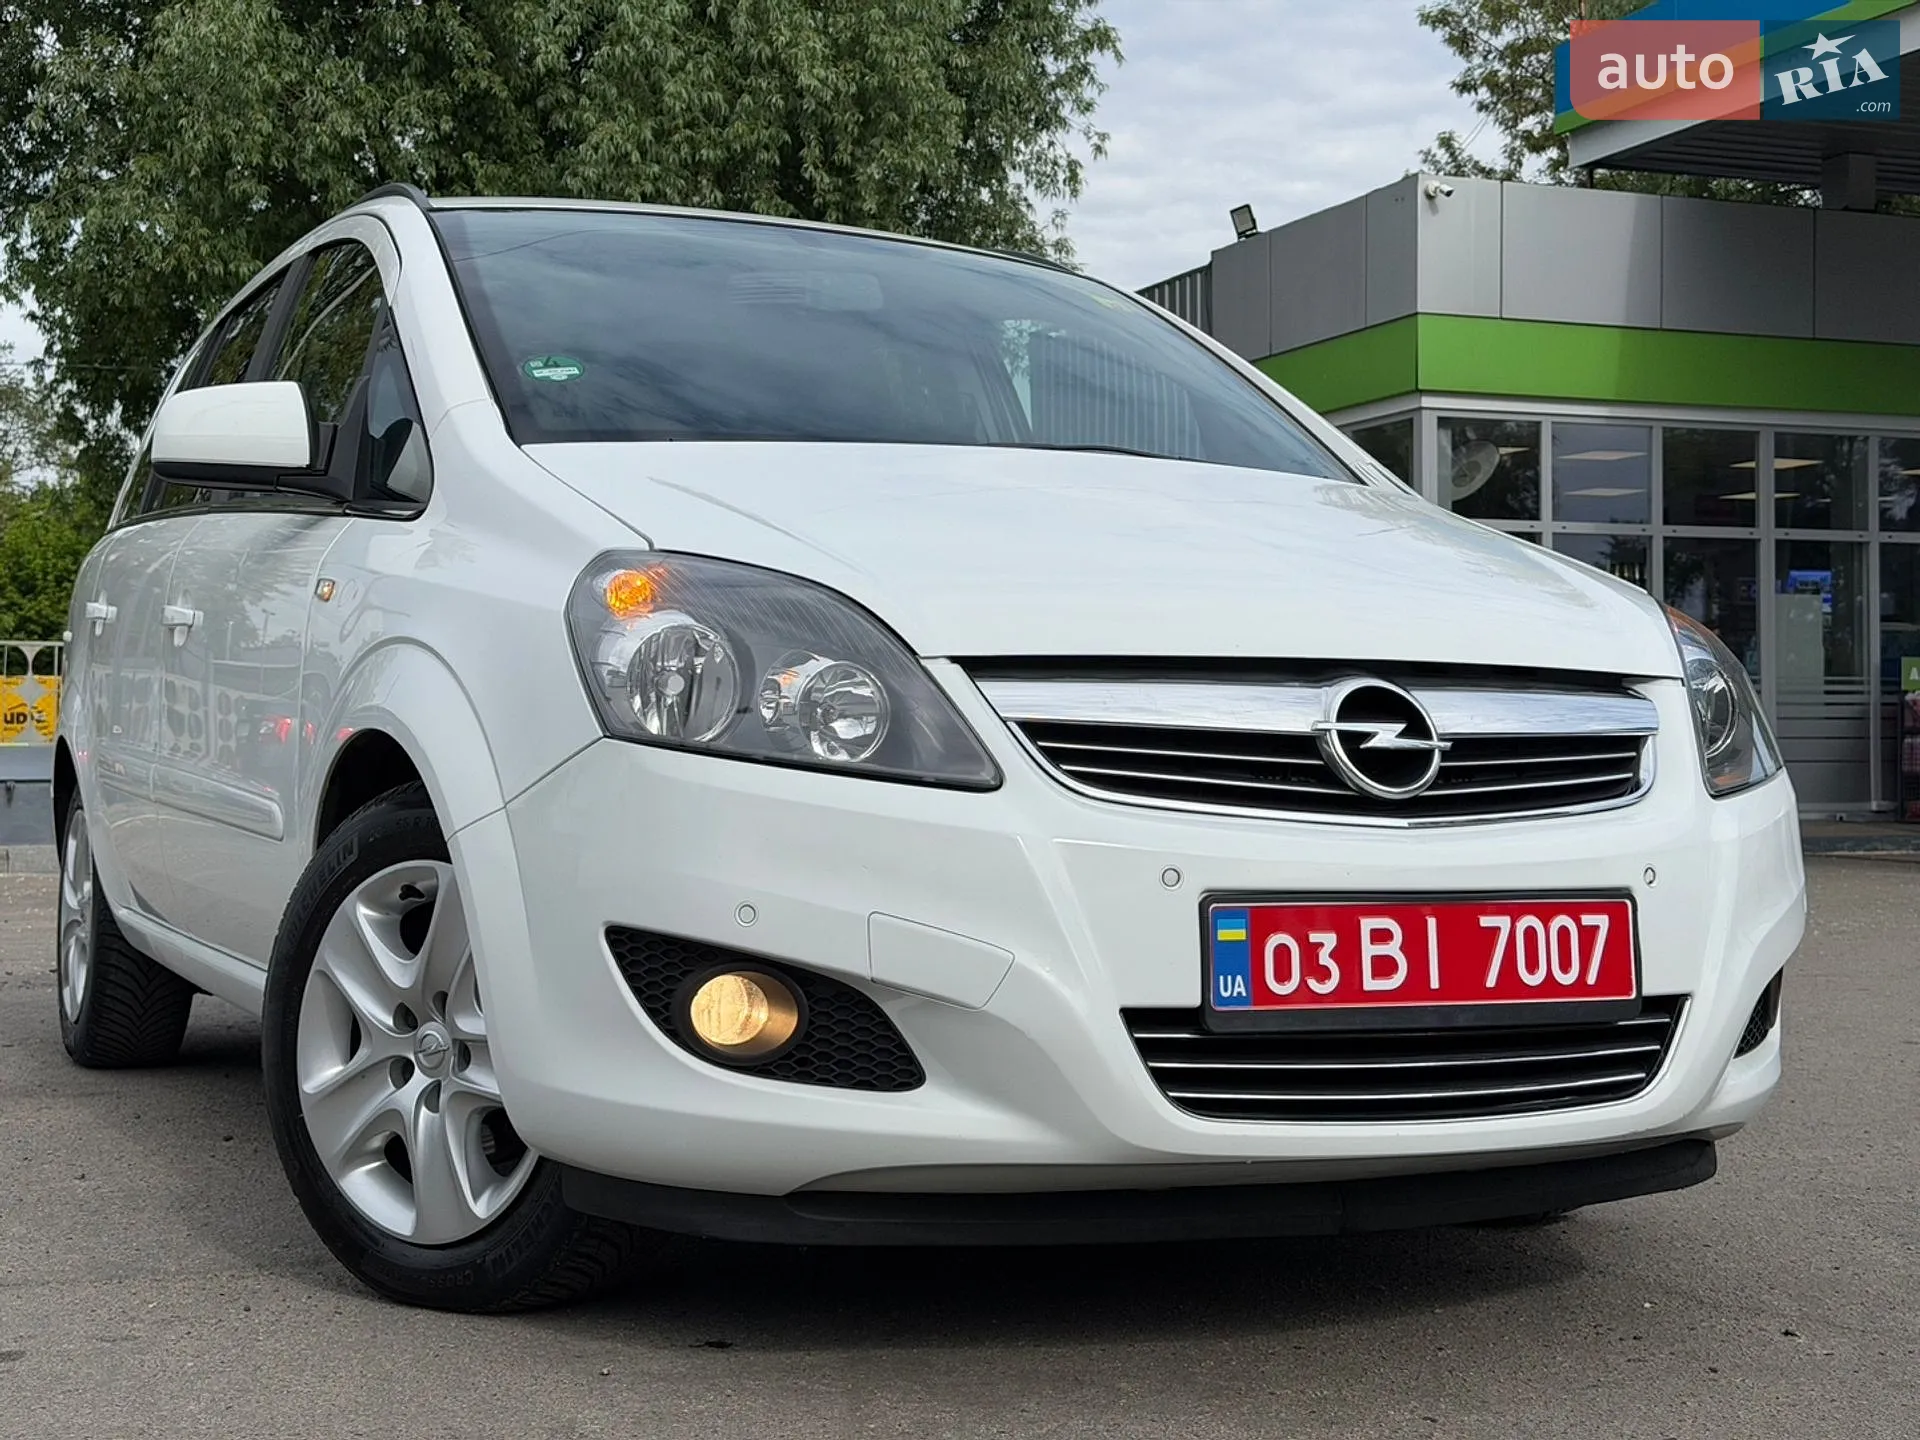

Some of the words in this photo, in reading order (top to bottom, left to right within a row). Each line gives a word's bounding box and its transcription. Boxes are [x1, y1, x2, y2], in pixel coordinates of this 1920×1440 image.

[1263, 931, 1340, 996] 03
[1358, 915, 1440, 991] BI
[1478, 914, 1610, 989] 7007
[1219, 974, 1247, 997] UA
